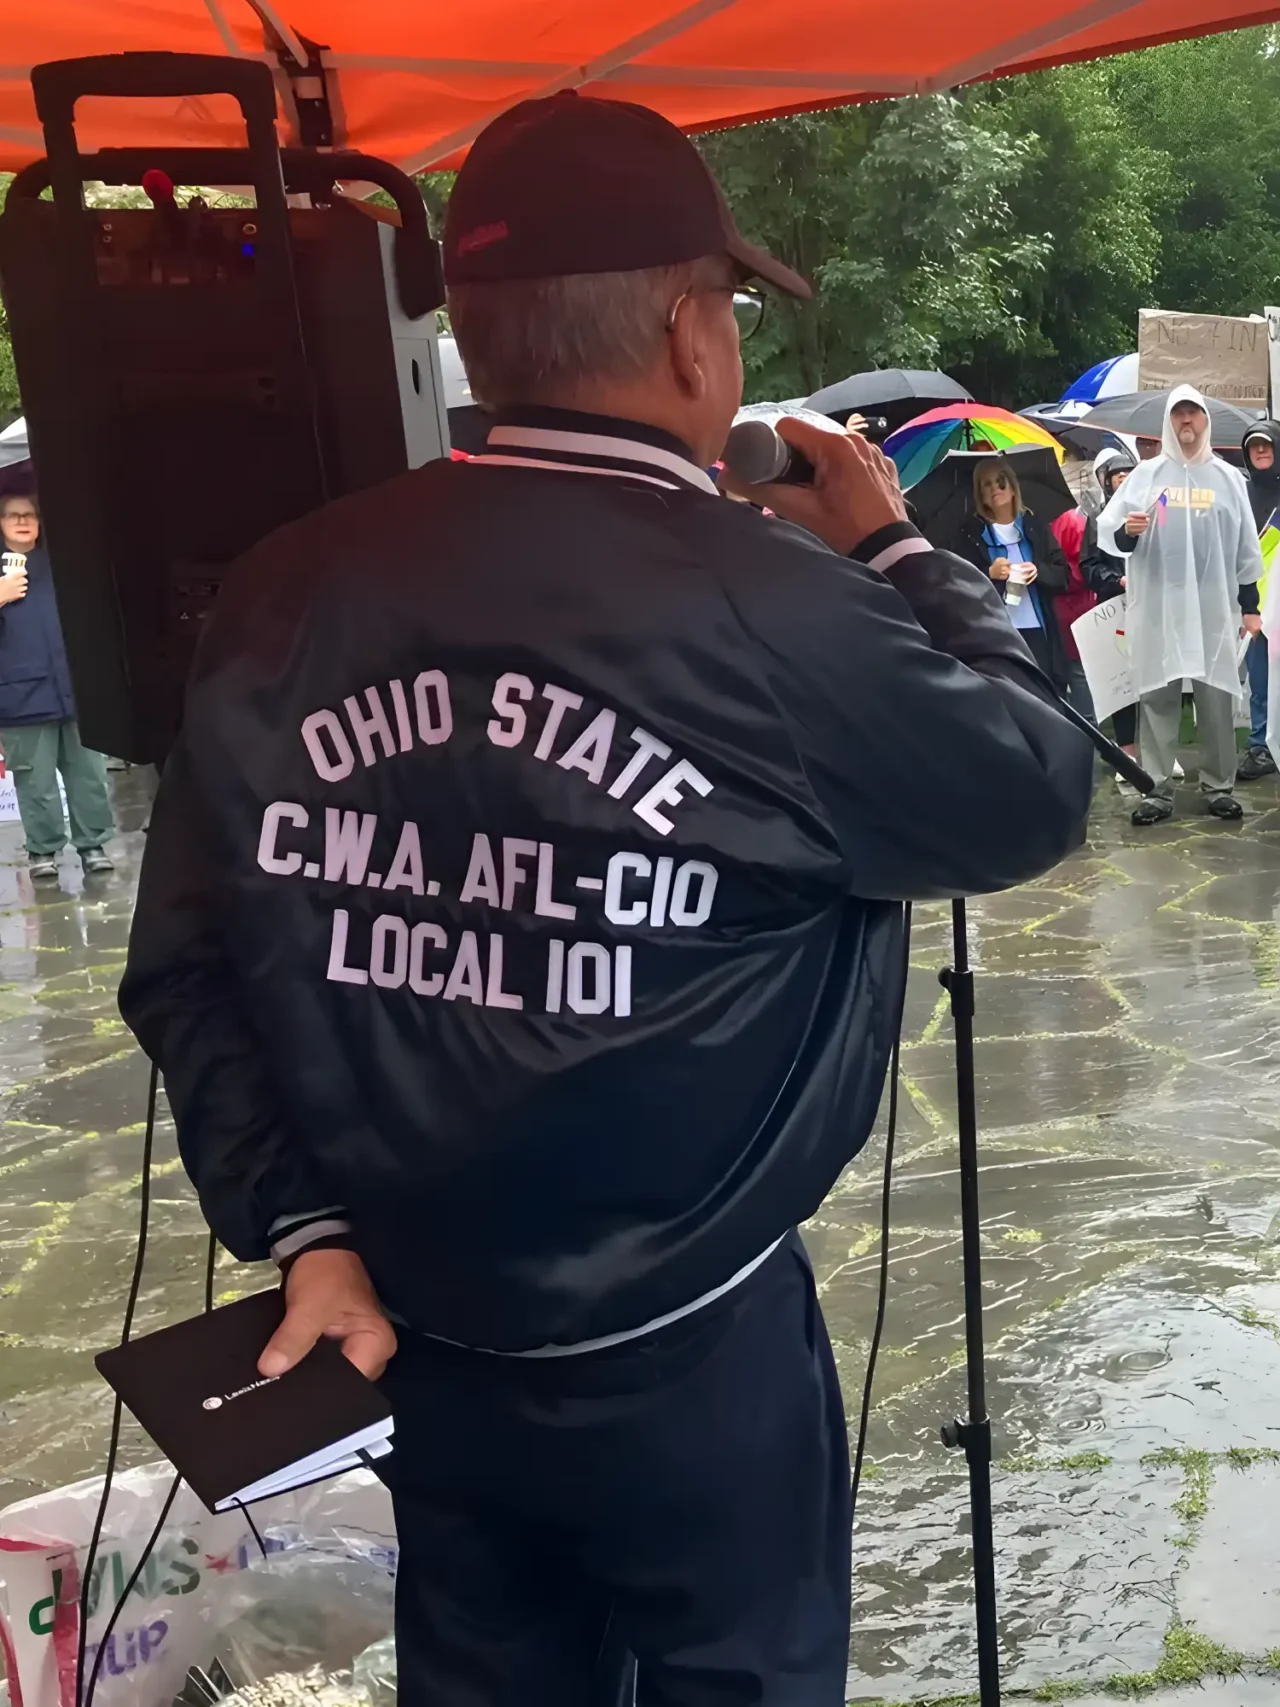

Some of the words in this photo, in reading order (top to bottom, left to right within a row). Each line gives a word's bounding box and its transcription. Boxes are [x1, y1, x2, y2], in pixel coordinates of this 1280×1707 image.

[301, 669, 454, 783] OHIO
[486, 672, 715, 836] STATE
[256, 801, 441, 896] C.W.A.
[459, 833, 719, 928] AFL-CIO
[326, 909, 524, 1011] LOCAL
